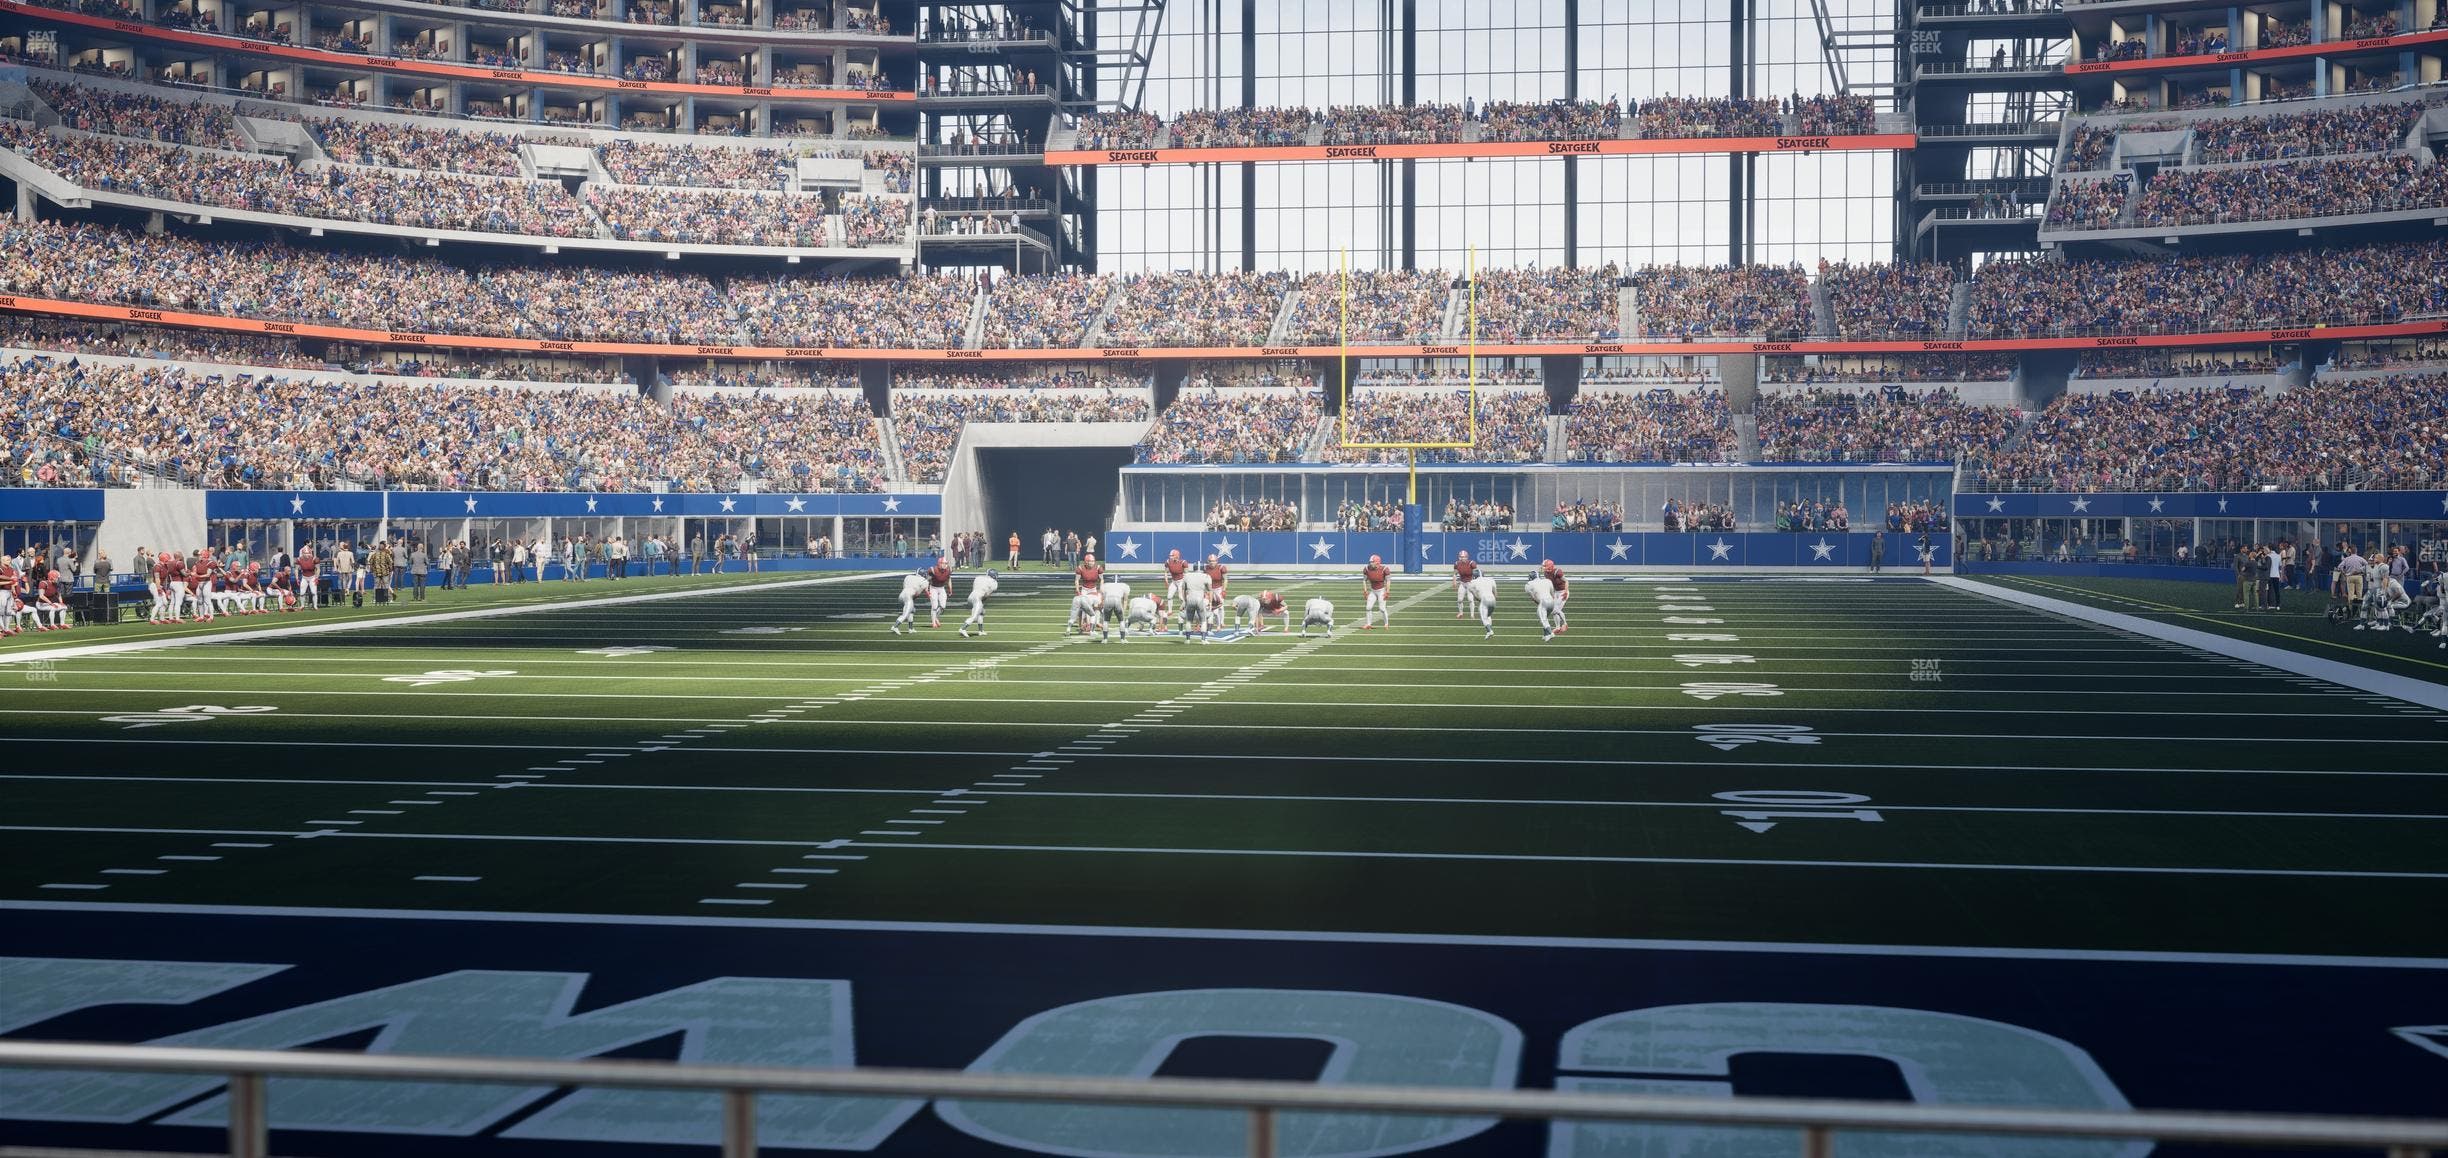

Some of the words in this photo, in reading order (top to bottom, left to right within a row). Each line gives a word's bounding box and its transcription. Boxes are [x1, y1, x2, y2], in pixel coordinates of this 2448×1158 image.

[241, 41, 269, 51] SEATGEEK
[2216, 52, 2248, 61] SEATGEEK
[367, 57, 396, 67] SEATGEEK
[2080, 63, 2110, 71] SEATGEEK
[493, 71, 522, 80] SEATGEEK
[1549, 142, 1600, 153] SEATGEEK
[1777, 138, 1829, 149] SEATGEEK
[1326, 147, 1376, 157] SEATGEEK
[1109, 152, 1157, 162] SEATGEEK
[130, 309, 162, 320] SEATGEEK
[264, 323, 294, 332] SEATGEEK
[390, 333, 425, 343] SEATGEEK
[2271, 330, 2311, 339] SEATGEEK
[540, 342, 573, 350] SEATGEEK
[1923, 342, 1963, 350] SEATGEEK
[2097, 337, 2138, 346] SEATGEEK
[698, 347, 733, 356] SEATGEEK
[1261, 348, 1298, 356] SEATGEEK
[1422, 346, 1458, 354] SEATGEEK
[1585, 344, 1623, 353] SEATGEEK
[1753, 343, 1791, 352] SEATGEEK
[786, 349, 822, 357] SEATGEEK
[946, 350, 982, 358] SEATGEEK
[1103, 349, 1139, 357] SEATGEEK
[98, 705, 279, 723] 20
[1692, 723, 1822, 745] 20
[1712, 790, 1885, 822] 10
